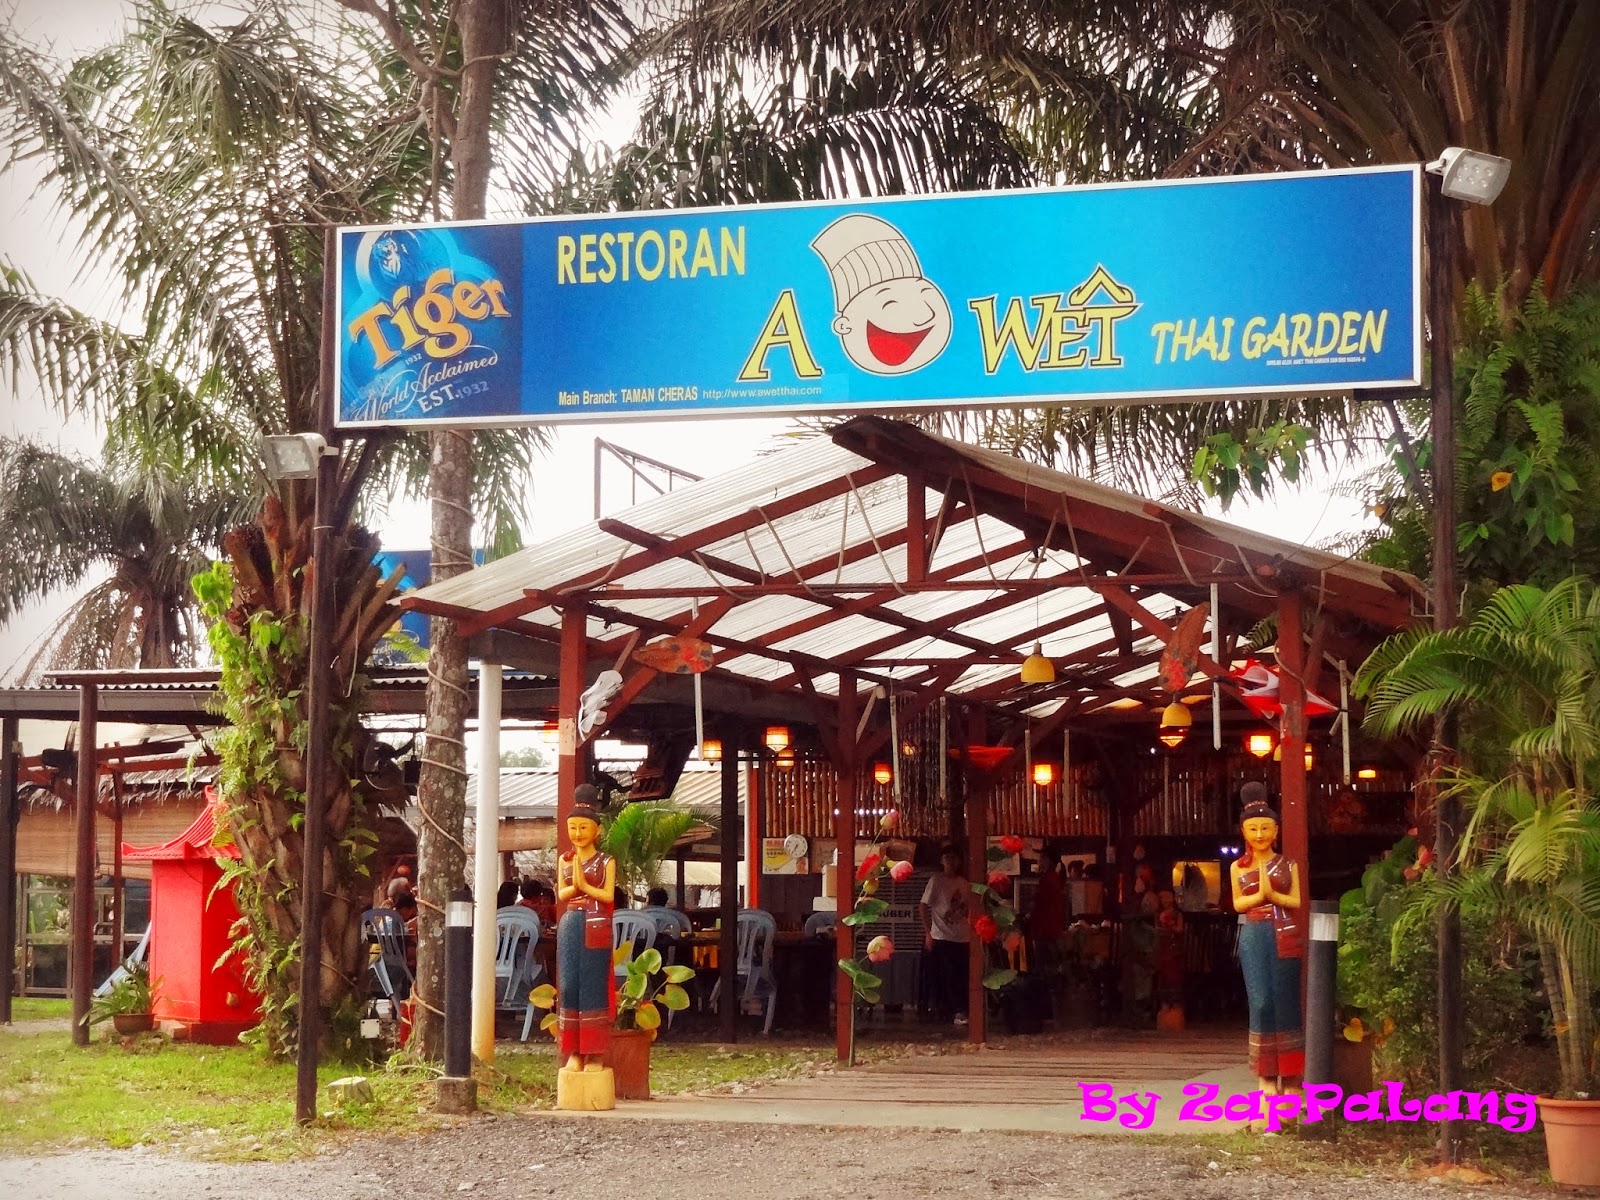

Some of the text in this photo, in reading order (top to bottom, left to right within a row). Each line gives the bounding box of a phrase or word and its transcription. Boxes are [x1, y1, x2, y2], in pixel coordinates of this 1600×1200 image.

[557, 225, 746, 285] RESTORAN
[348, 267, 512, 370] Tiger
[735, 287, 825, 383] A
[1150, 316, 1235, 365] THAI
[1240, 308, 1389, 360] GARDEN
[350, 344, 499, 421] World Acclaimed
[405, 353, 423, 366] 1932
[416, 380, 490, 414] EST. 1932
[558, 386, 822, 406] Main Branch: TAMAN CHERAS http://www.awetthai.com
